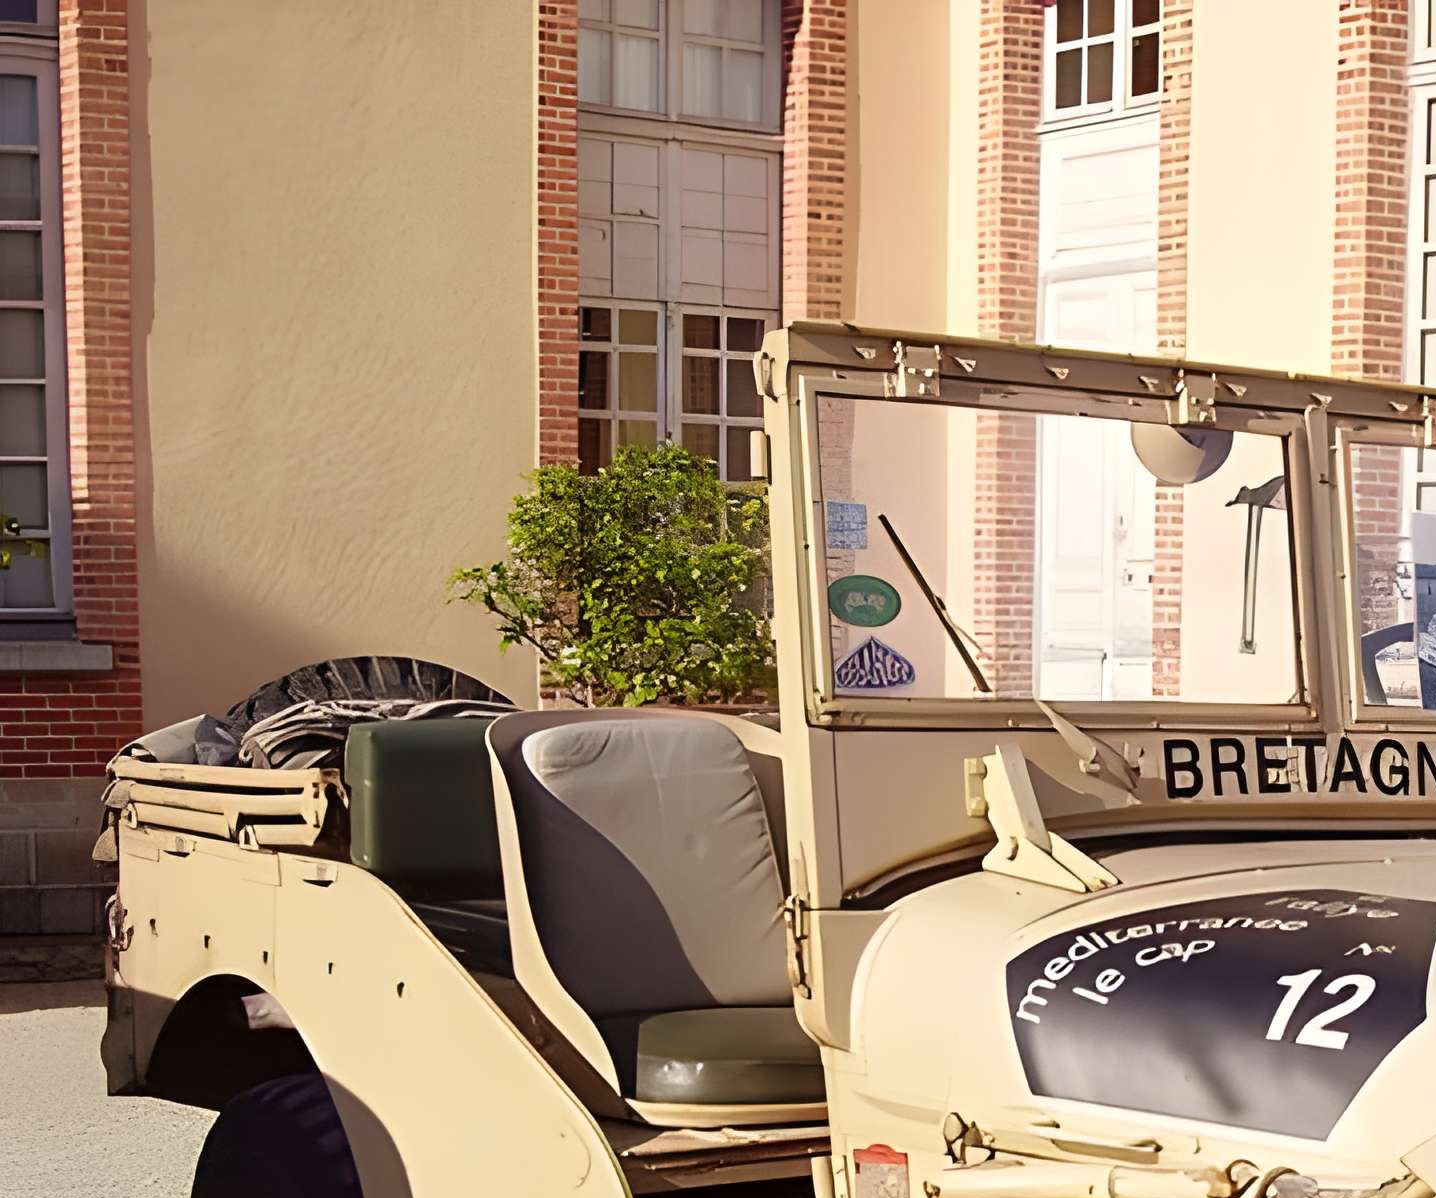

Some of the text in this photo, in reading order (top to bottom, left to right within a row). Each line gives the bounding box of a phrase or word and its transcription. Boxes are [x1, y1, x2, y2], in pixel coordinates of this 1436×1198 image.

[1071, 939, 1216, 1005] le cap
[1265, 968, 1377, 1051] 12
